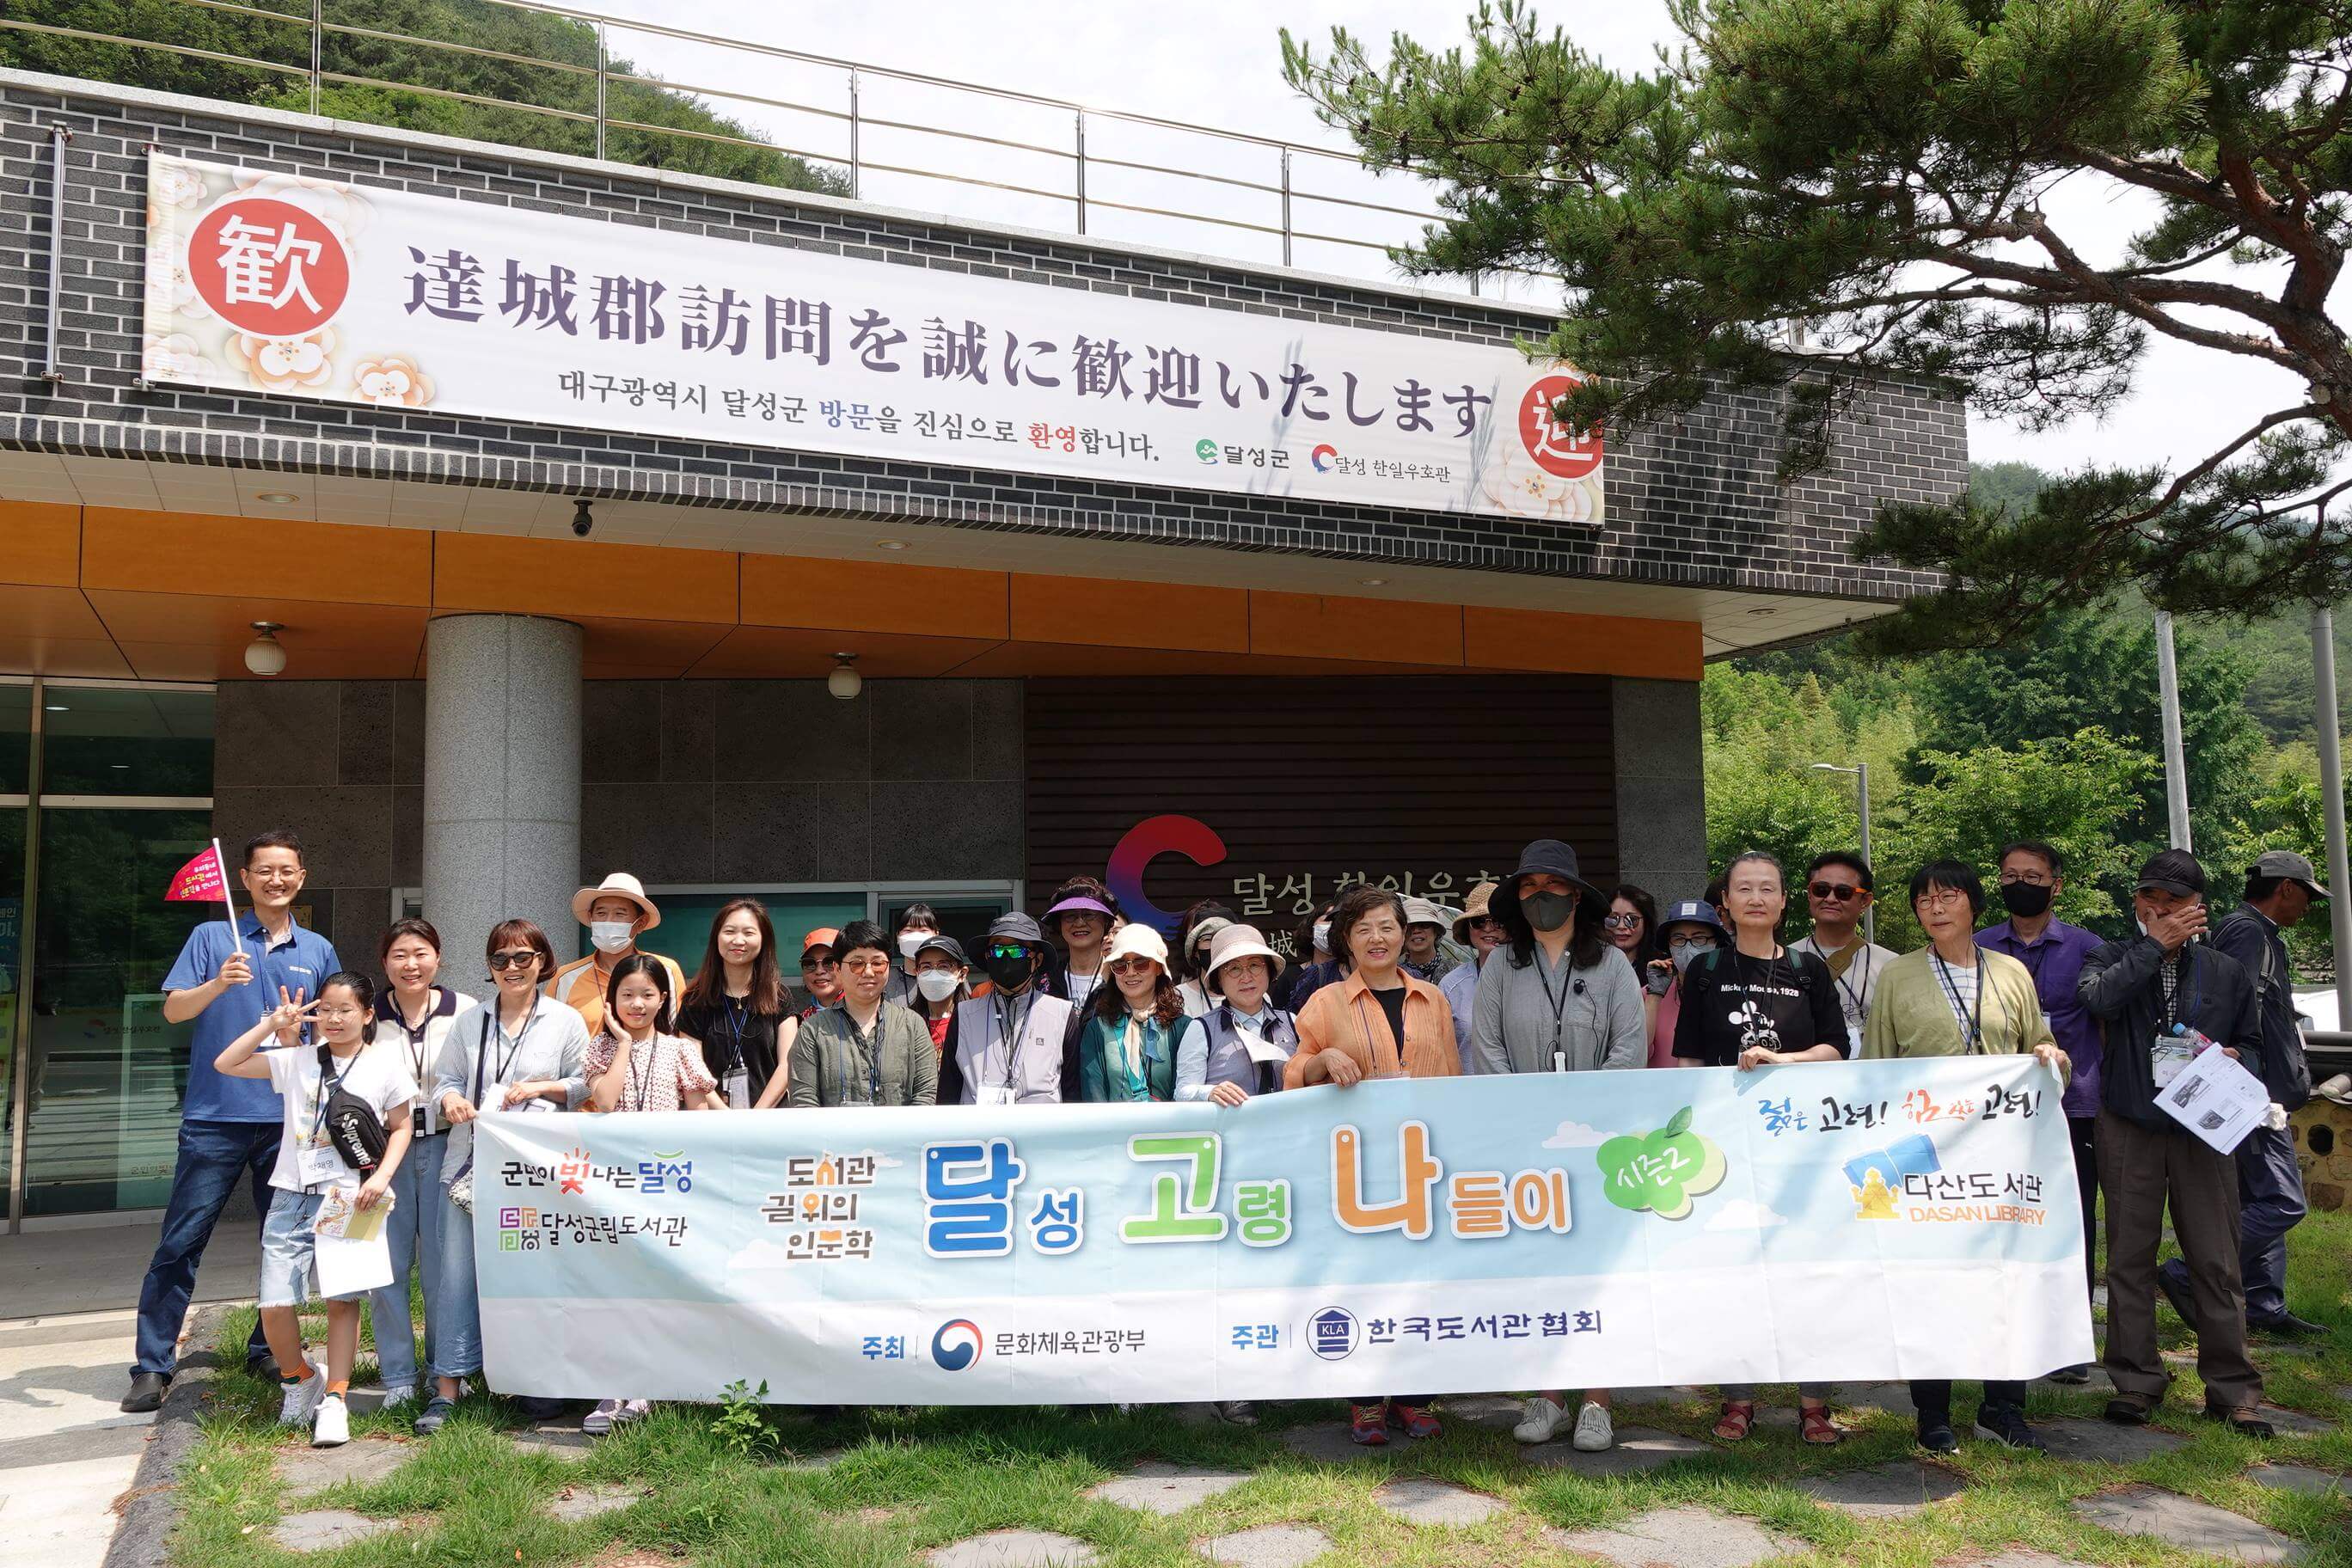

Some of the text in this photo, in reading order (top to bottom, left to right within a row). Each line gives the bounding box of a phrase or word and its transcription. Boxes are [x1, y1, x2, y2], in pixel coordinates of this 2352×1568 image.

[217, 214, 323, 315] 歓
[403, 245, 1493, 438] 達城郡訪問を誠に歓迎いたします
[558, 370, 1160, 462] 대구광역시 달성군 방문을 진심으로 환영합니다.
[1223, 444, 1289, 469] 달성군
[1334, 456, 1451, 484] 달성 한일우호관
[1234, 872, 1313, 916] 달성
[1779, 987, 1800, 997] 1928
[1817, 1096, 1889, 1133] 고령!
[1981, 1083, 2042, 1121] 고령!
[639, 1160, 693, 1194] 달성
[787, 1155, 876, 1187] 도서관
[1335, 1124, 1570, 1236] 나들이
[1616, 1146, 1691, 1189] 시즌2
[924, 1142, 1081, 1255] 달성
[1123, 1135, 1289, 1243] 고령
[541, 1211, 689, 1247] 달성군립도서관
[1908, 1204, 2047, 1226] DASAN LIBRARY
[787, 1230, 873, 1260] 인문학
[994, 1330, 1147, 1357] 문화체육관광부
[1230, 1324, 1280, 1351] 주관
[1320, 1323, 1345, 1336] KLA
[862, 1336, 905, 1361] 주최
